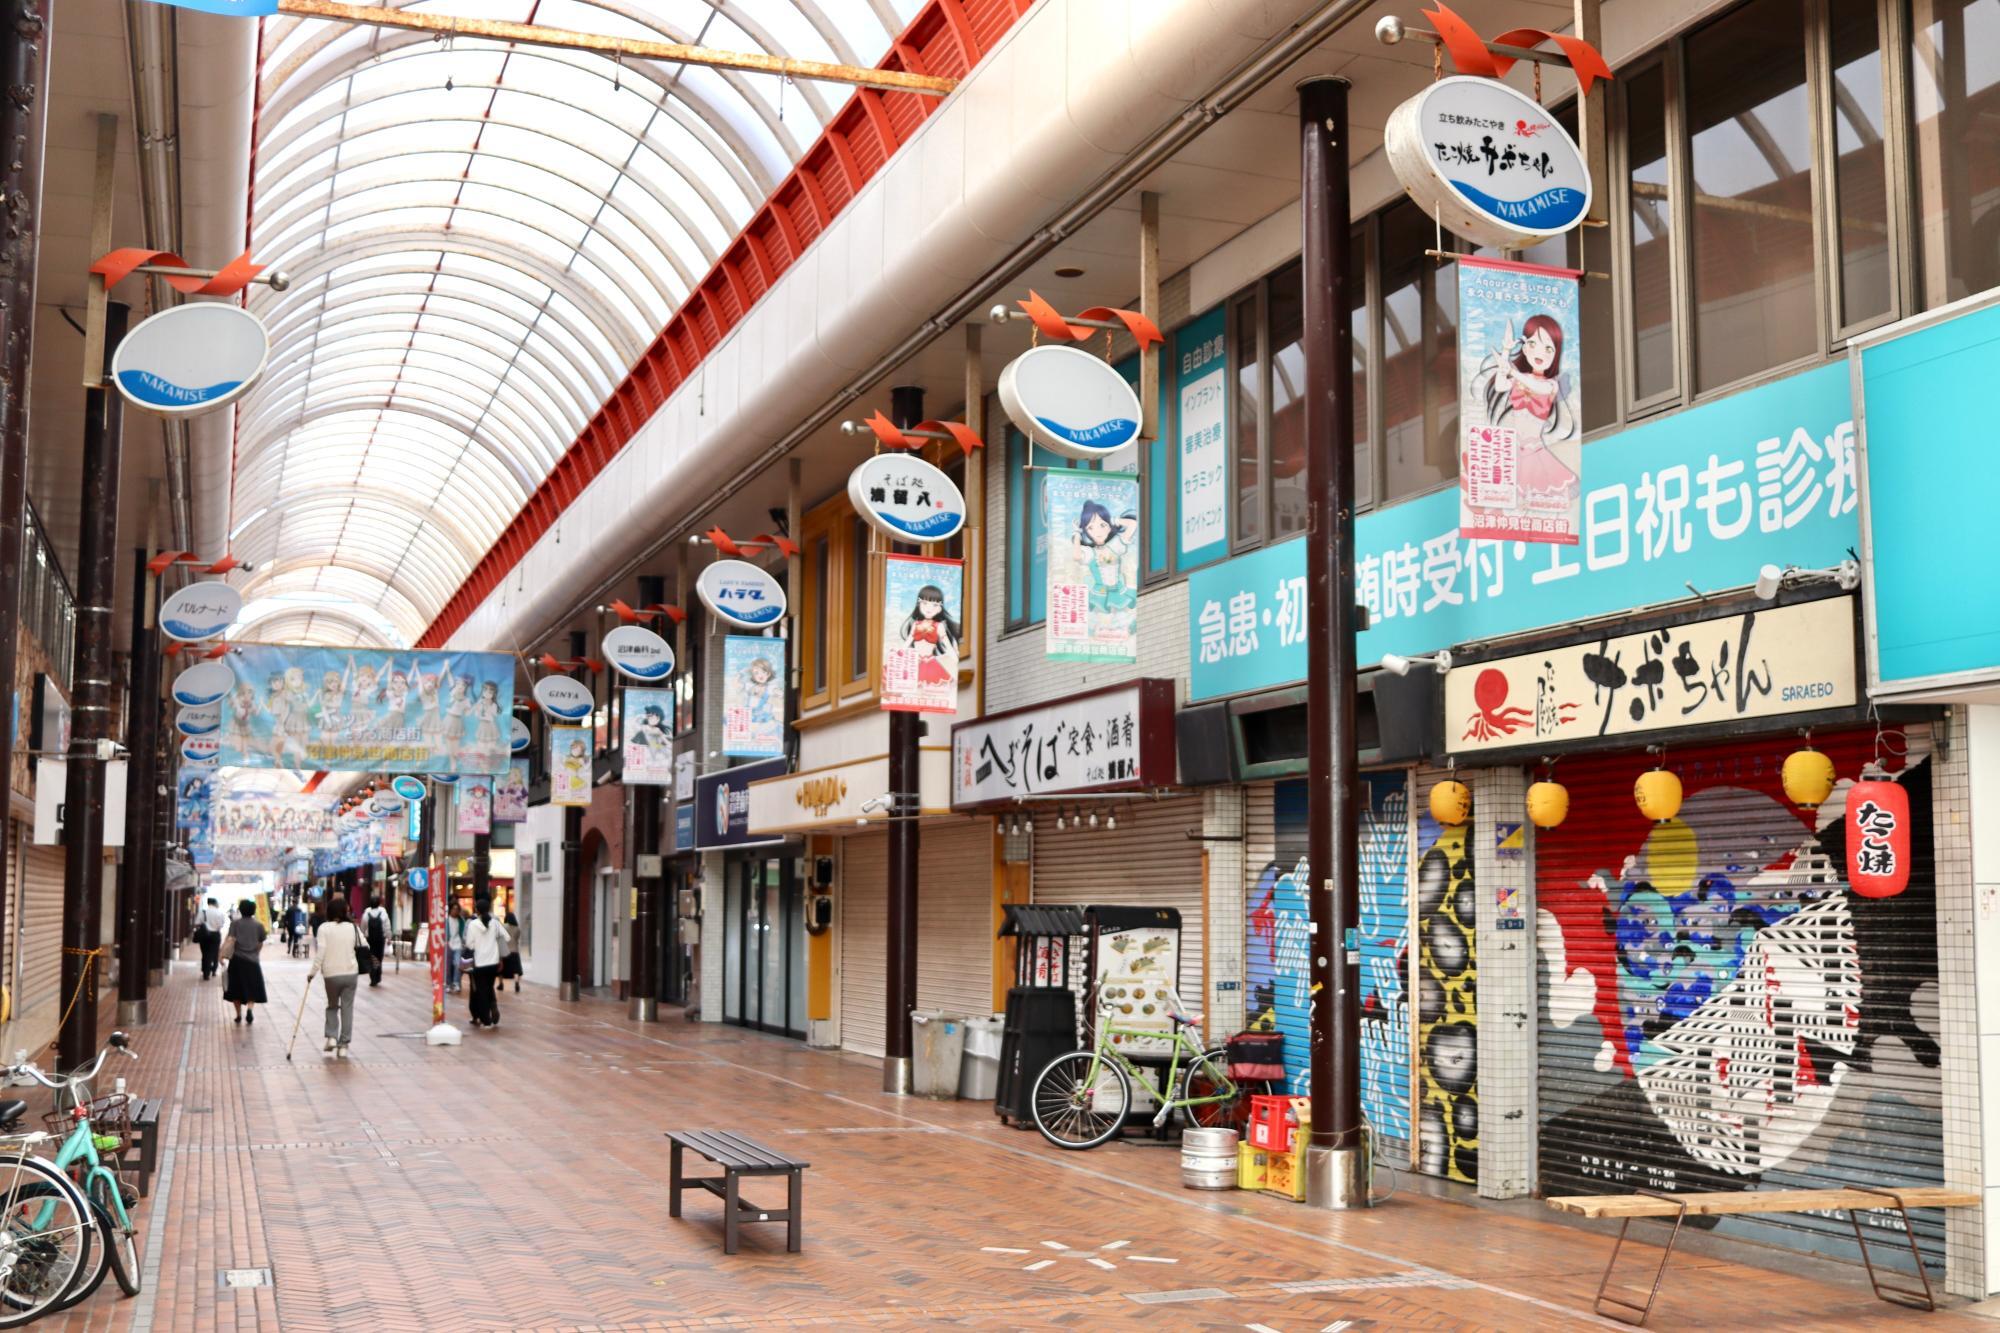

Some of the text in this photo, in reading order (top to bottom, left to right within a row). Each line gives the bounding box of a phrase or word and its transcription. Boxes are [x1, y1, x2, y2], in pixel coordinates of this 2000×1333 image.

[1438, 113, 1505, 131] 立ち飲みたこやき
[1496, 188, 1570, 219] NAKAMISE
[1183, 333, 1225, 375] 自由診療
[136, 372, 209, 401] NAKAMISE
[1069, 420, 1125, 442] NAKAMISE
[884, 473, 925, 489] そば処
[904, 512, 951, 532] NAKAMISE
[719, 588, 765, 601] ハラダ
[176, 602, 228, 616] パルナード
[1782, 682, 1833, 701] SARAEBO
[1857, 801, 1896, 875] たこ焼
